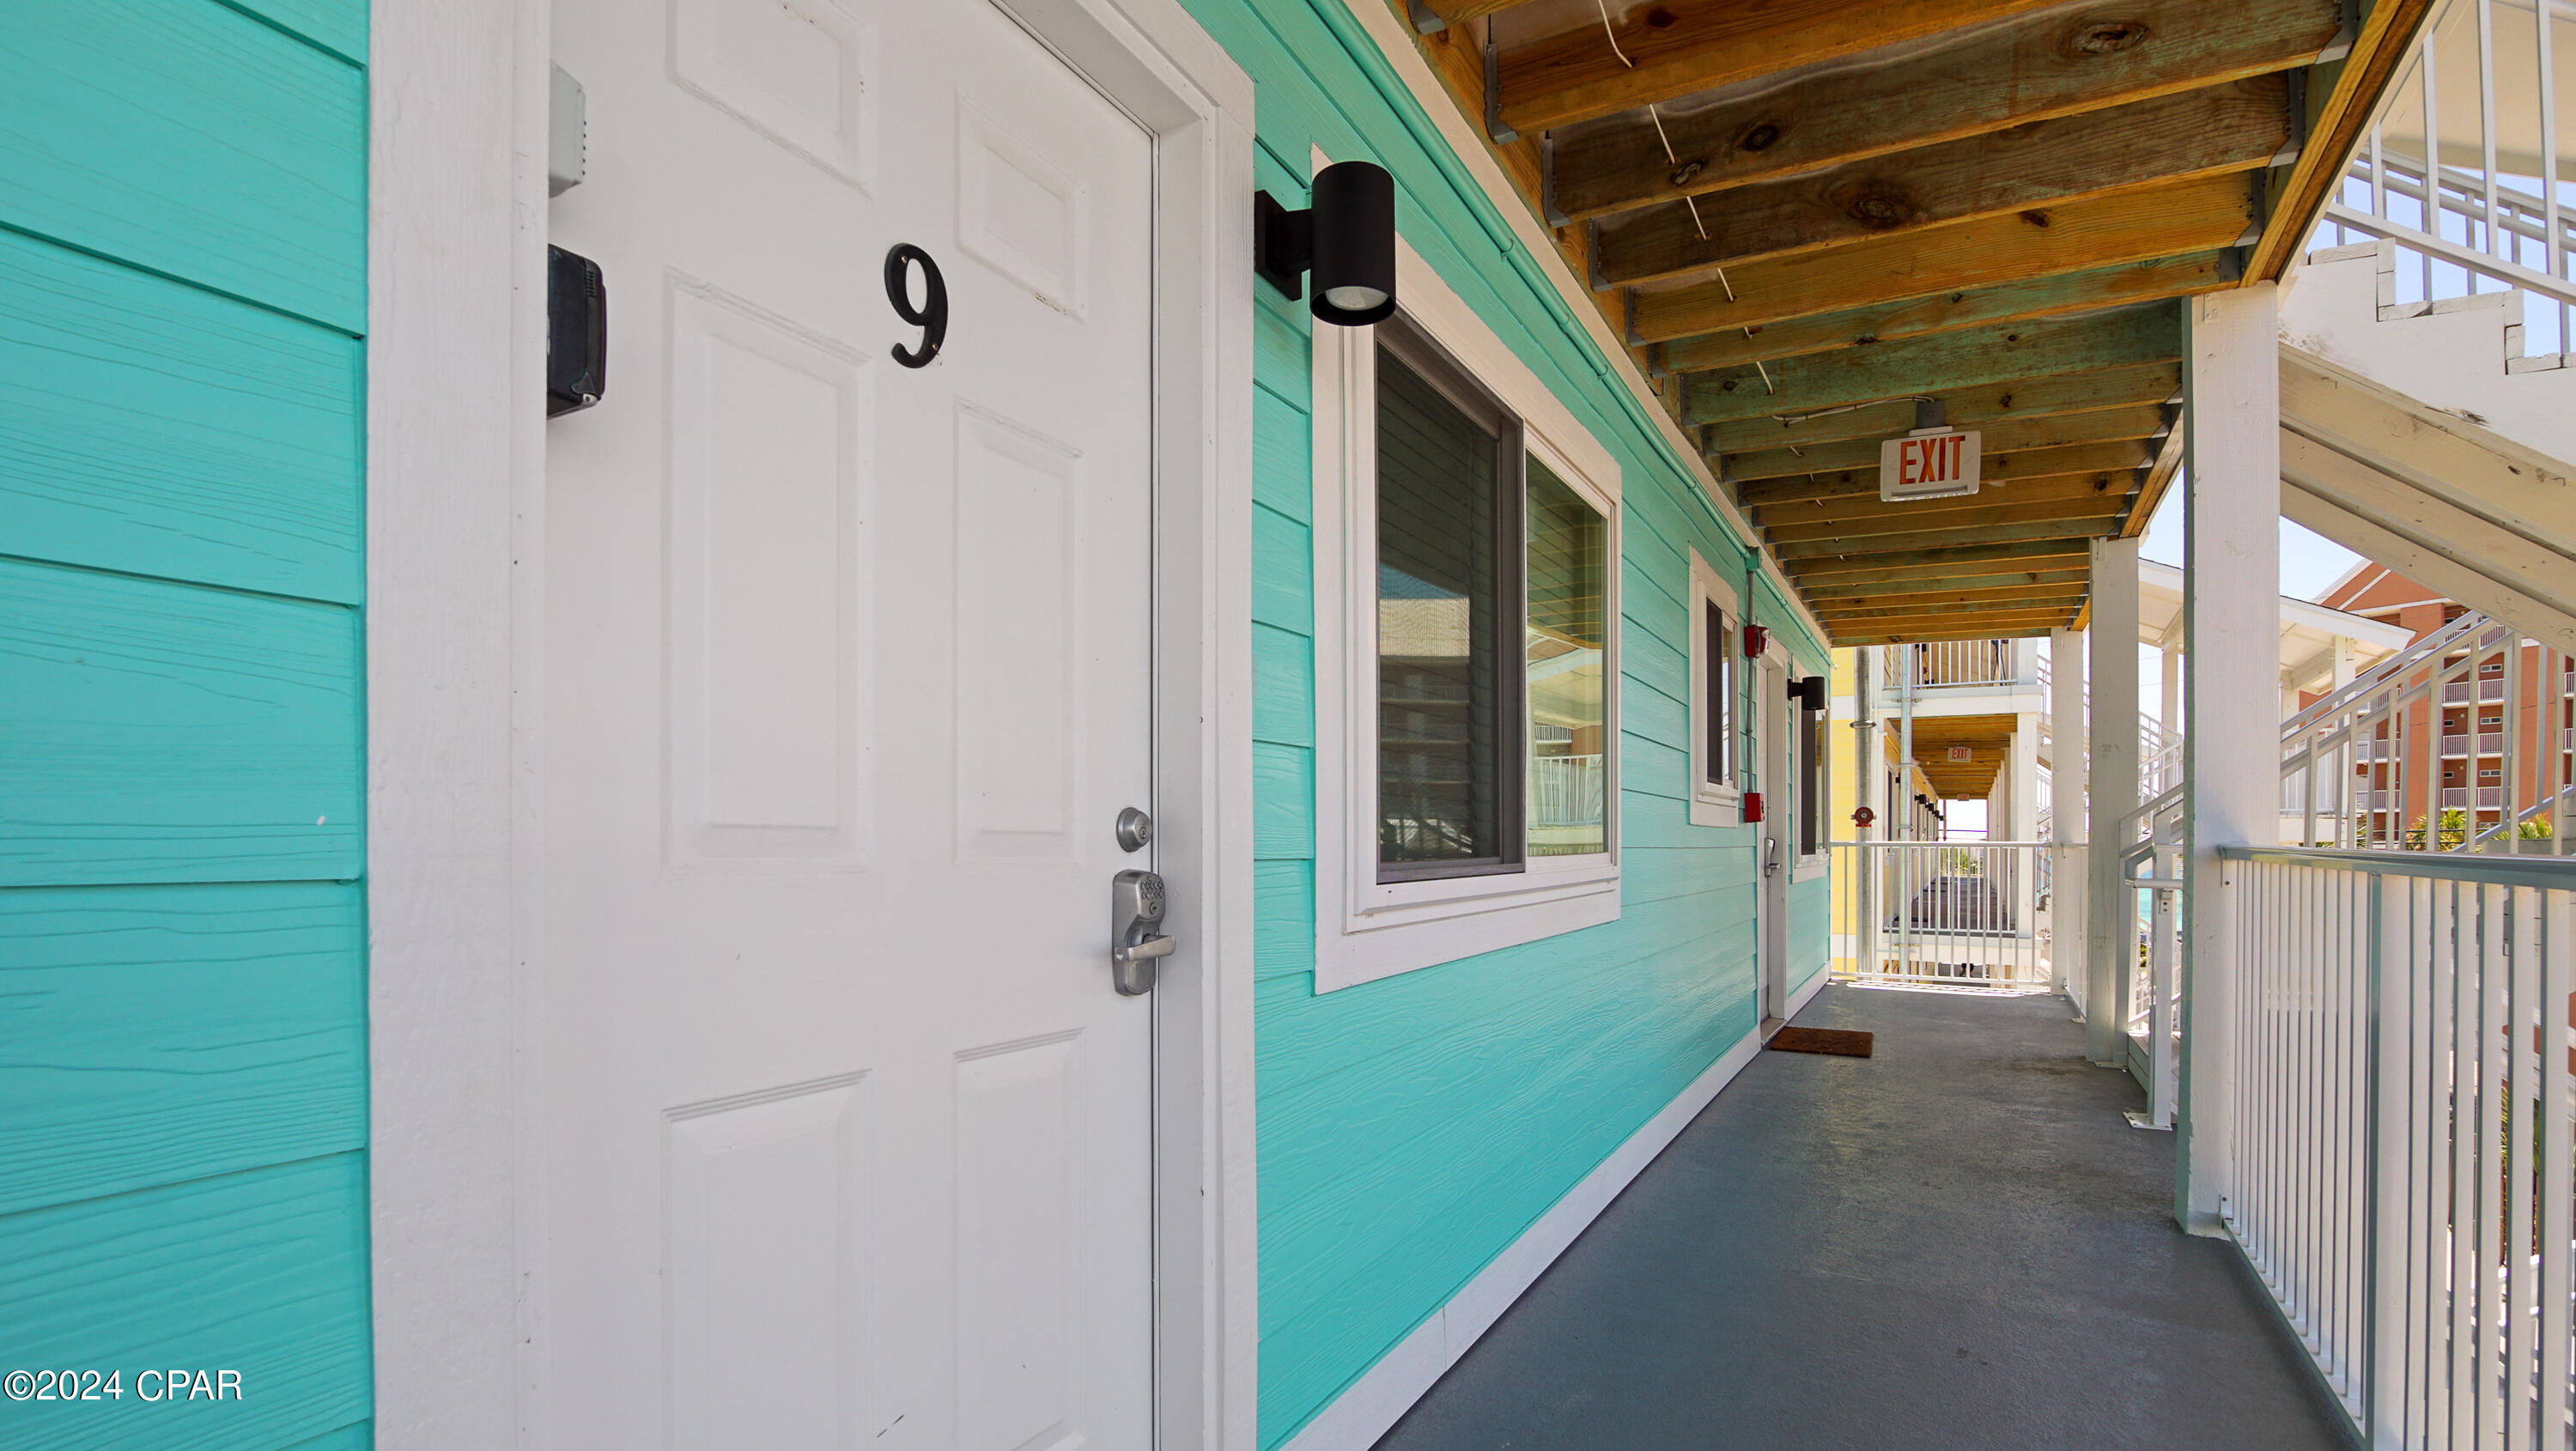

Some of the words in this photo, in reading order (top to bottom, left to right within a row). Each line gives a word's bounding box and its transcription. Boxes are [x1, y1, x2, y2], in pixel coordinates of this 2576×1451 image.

[884, 242, 948, 368] 9
[1899, 435, 1965, 484] EXIT
[1952, 748, 1968, 759] EXIT
